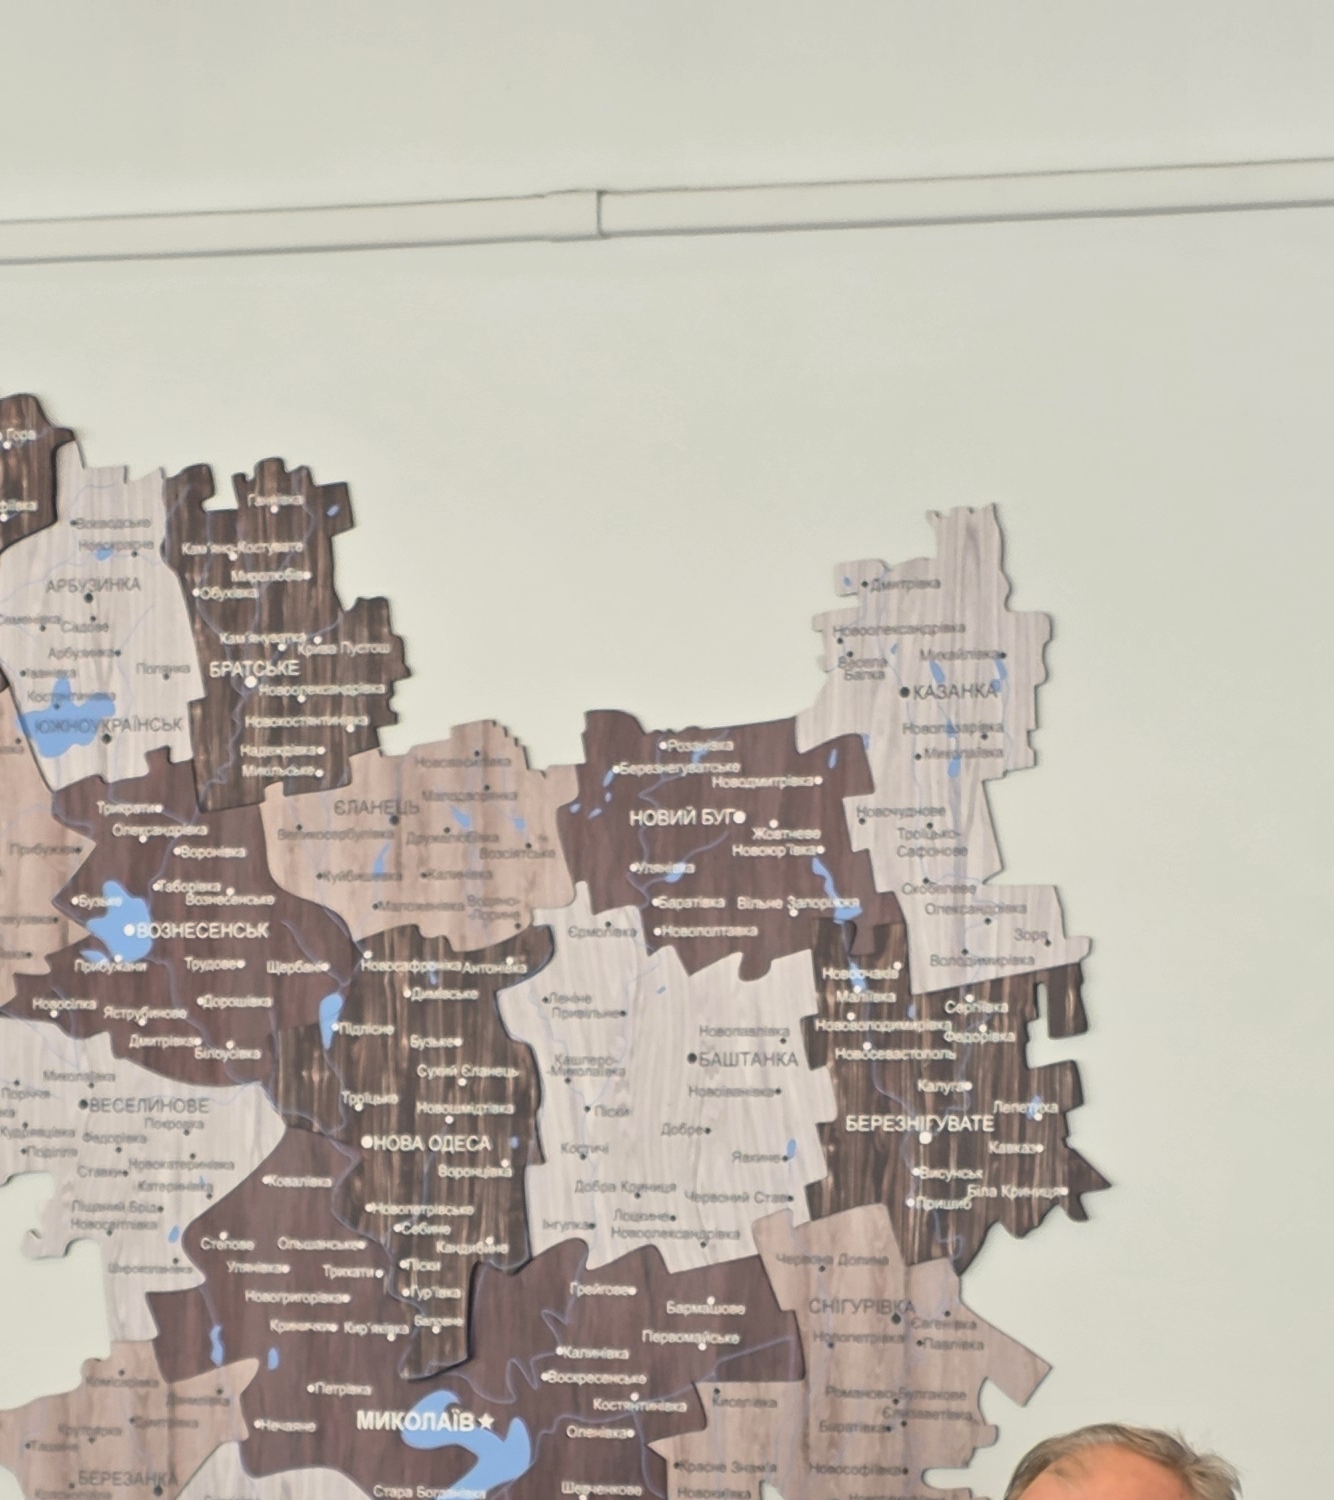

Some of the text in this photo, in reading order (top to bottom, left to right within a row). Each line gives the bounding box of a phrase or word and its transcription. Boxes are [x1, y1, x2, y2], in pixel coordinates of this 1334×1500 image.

[45, 578, 140, 593] АРБУЗИНКА
[209, 660, 300, 678] БРАТСЬКЕ
[913, 685, 997, 700] КАЗАНКА
[334, 800, 420, 816] ЄЛАНЕЦЬ
[630, 808, 733, 825] НОВИЙ БУГ
[137, 922, 268, 938] ВОЗНЕСЕНСЬК
[699, 1052, 799, 1067] БАШТАНКА
[90, 1098, 209, 1114] ВЕСЕЛИНОВЕ
[846, 1114, 994, 1132] БЕРЕЗНІГУВАТЕ
[373, 1136, 490, 1152] НОВА ОДЕСА
[809, 1299, 915, 1315] СНІГУРІВКА
[357, 1409, 474, 1431] МИКОЛАЇВ
[78, 1471, 178, 1486] БЕРЕЗАНКА
